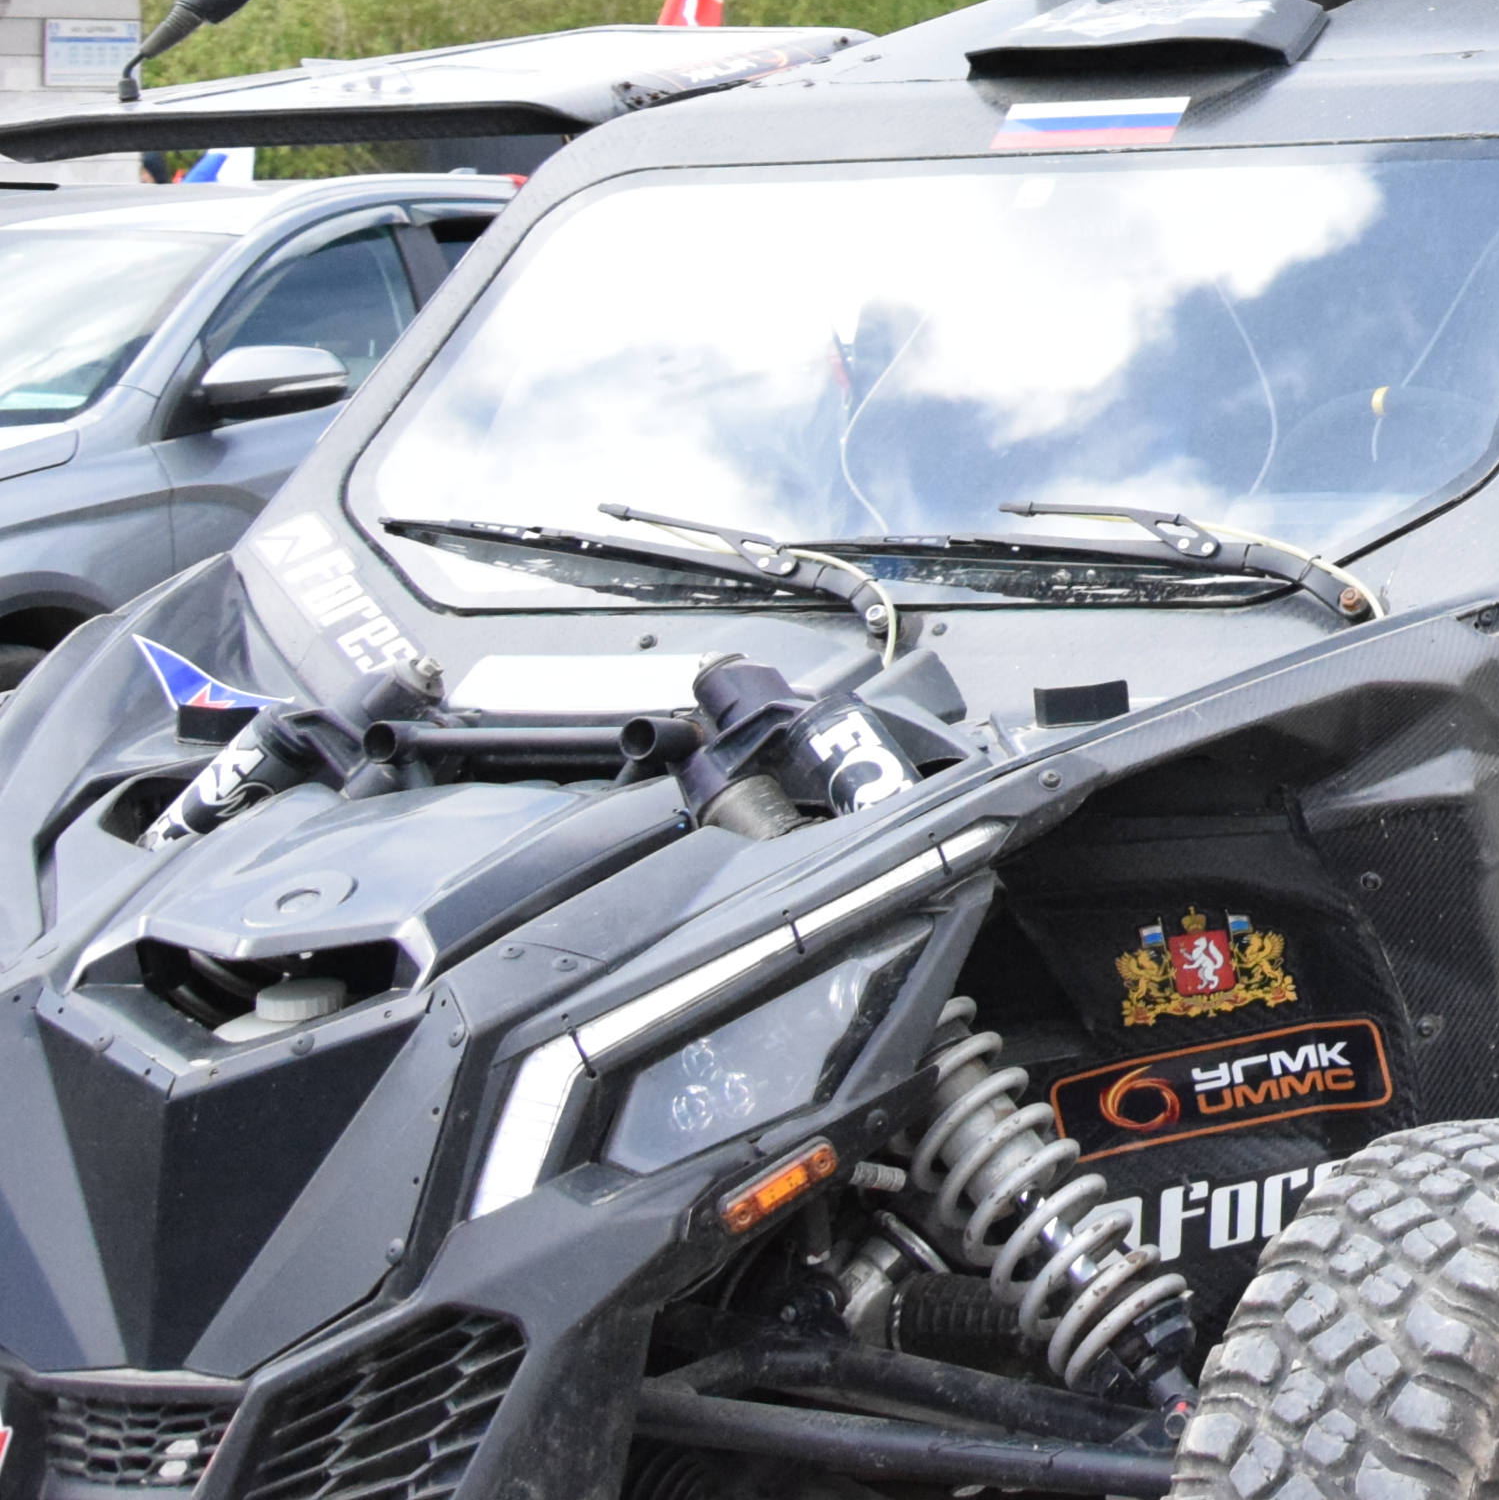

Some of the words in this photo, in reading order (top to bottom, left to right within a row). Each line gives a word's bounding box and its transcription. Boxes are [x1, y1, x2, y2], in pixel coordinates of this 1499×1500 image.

[809, 711, 914, 813] FO
[1191, 1041, 1351, 1092] УГМК
[1196, 1067, 1356, 1114] UMMC
